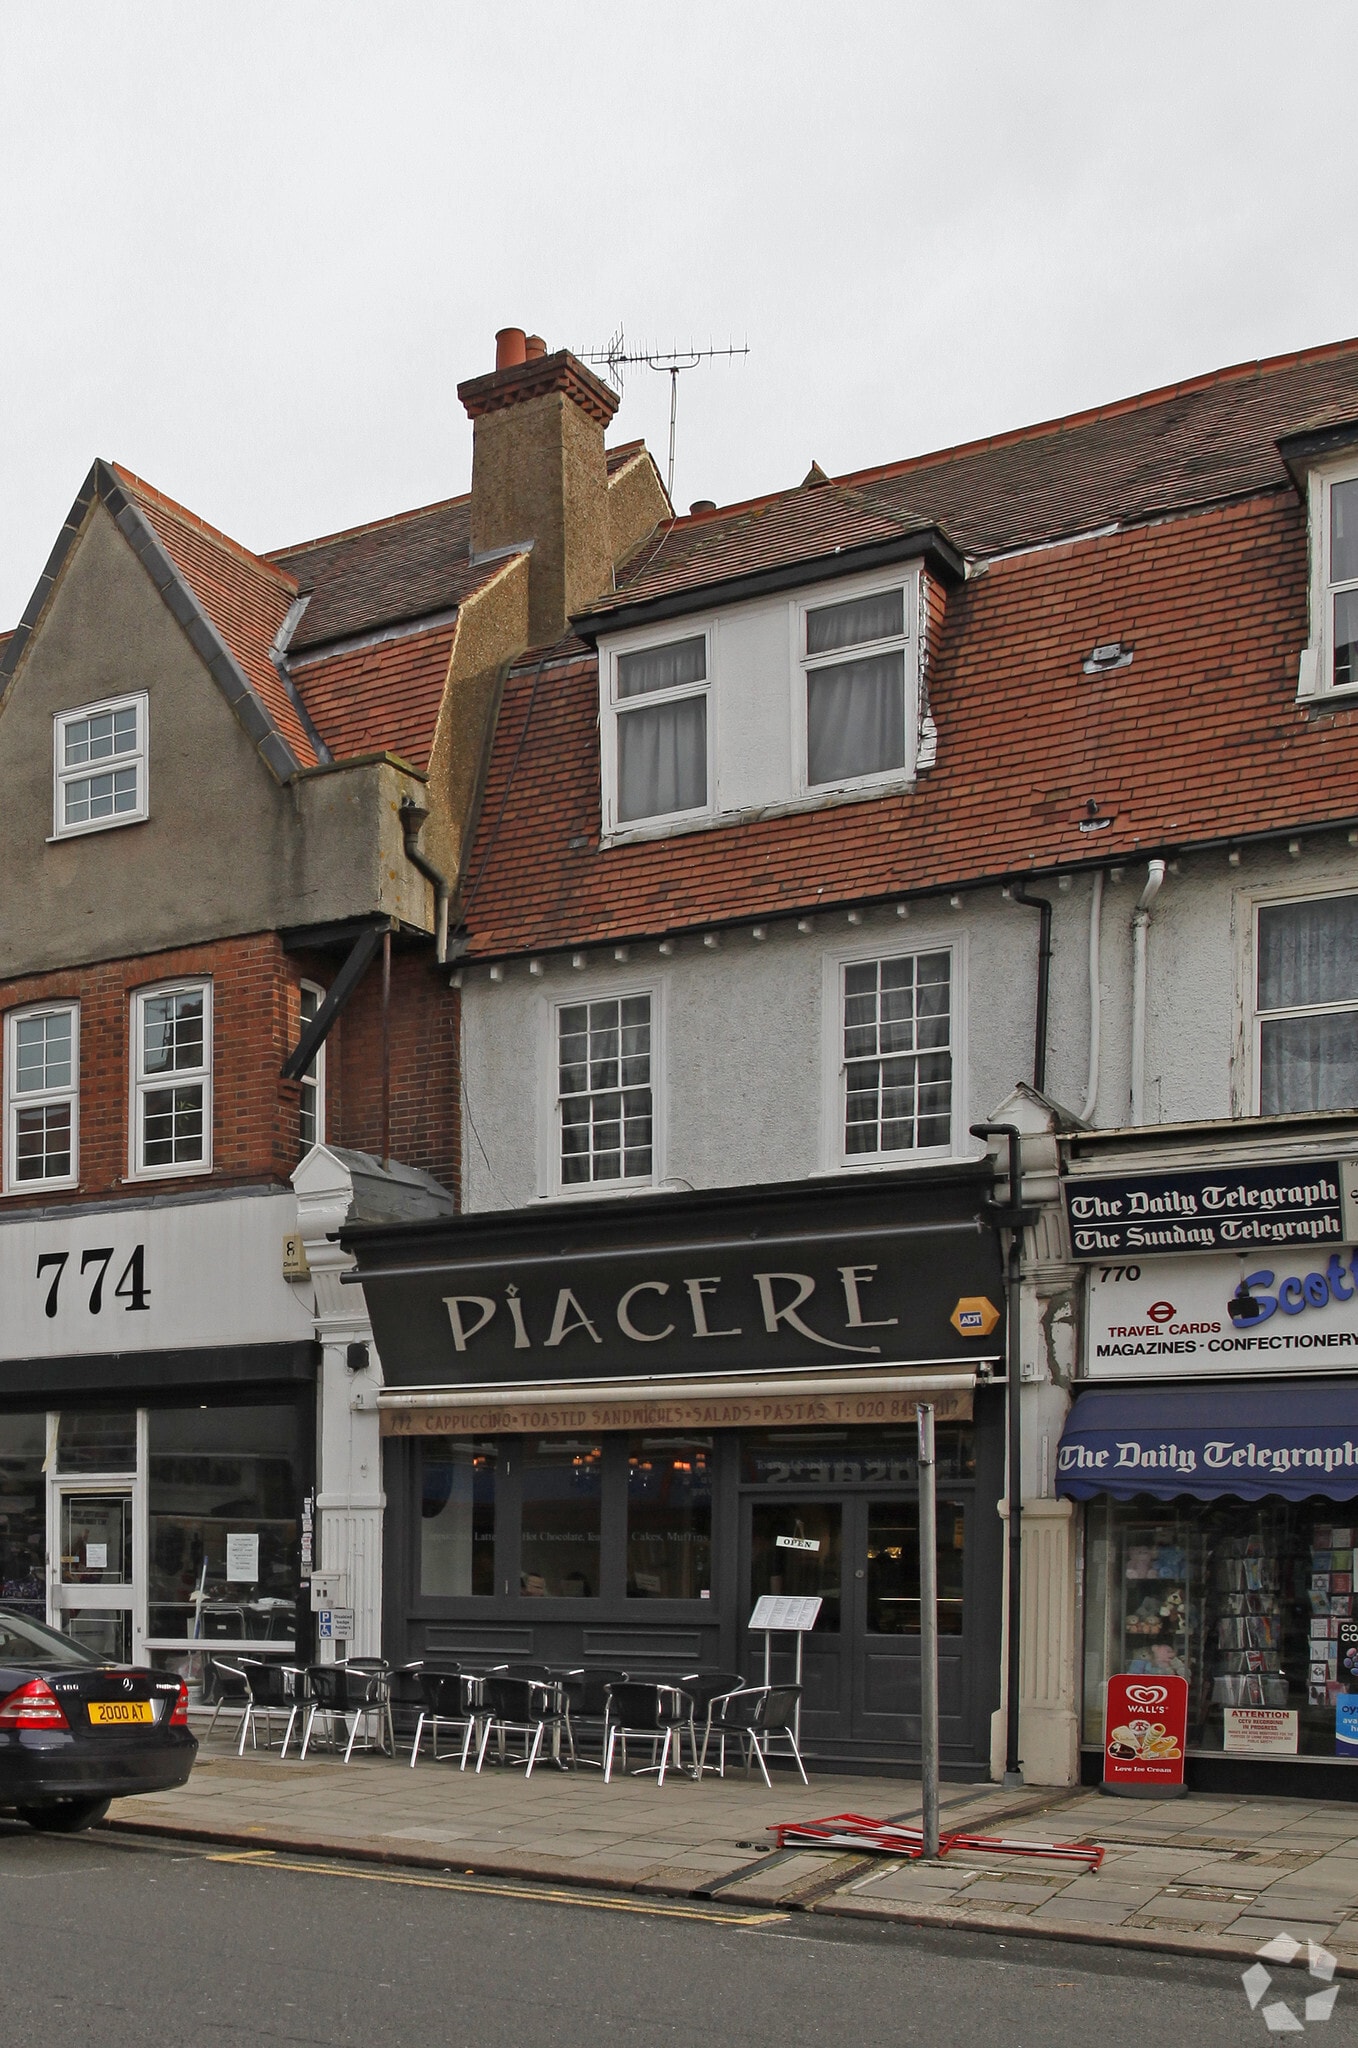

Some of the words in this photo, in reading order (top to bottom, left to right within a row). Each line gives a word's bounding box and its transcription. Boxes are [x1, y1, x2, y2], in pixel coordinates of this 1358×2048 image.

[1071, 1197, 1123, 1219] The
[1126, 1191, 1198, 1216] Daily
[1201, 1179, 1338, 1211] Telegraph
[1075, 1230, 1121, 1250] The
[1126, 1225, 1215, 1247] Sunday
[1220, 1215, 1341, 1242] Telegraph
[36, 1244, 151, 1319] 774
[1098, 1265, 1141, 1283] 770
[442, 1264, 898, 1354] PIACERE
[960, 1314, 982, 1325] ADT
[1108, 1324, 1164, 1338] TRAVEL
[1168, 1321, 1221, 1336] CARDS
[1096, 1340, 1197, 1357] MAGAZINES
[1207, 1333, 1358, 1353] CONFECTIONERY
[520, 1411, 587, 1427] TOASTED
[592, 1405, 683, 1425] SANDWICHES
[692, 1406, 752, 1421] SALADS
[762, 1402, 827, 1420] PASTAS
[856, 1401, 885, 1417] 020
[890, 1400, 925, 1416] 845
[1058, 1445, 1109, 1471] The
[1113, 1441, 1197, 1473] Daily
[1203, 1440, 1358, 1473] Telegraph
[783, 1538, 812, 1548] OPEN
[98, 1704, 129, 1721] 2000
[132, 1704, 144, 1720] AT
[1127, 1705, 1165, 1714] WALL'S
[1231, 1710, 1290, 1719] ATTENTION
